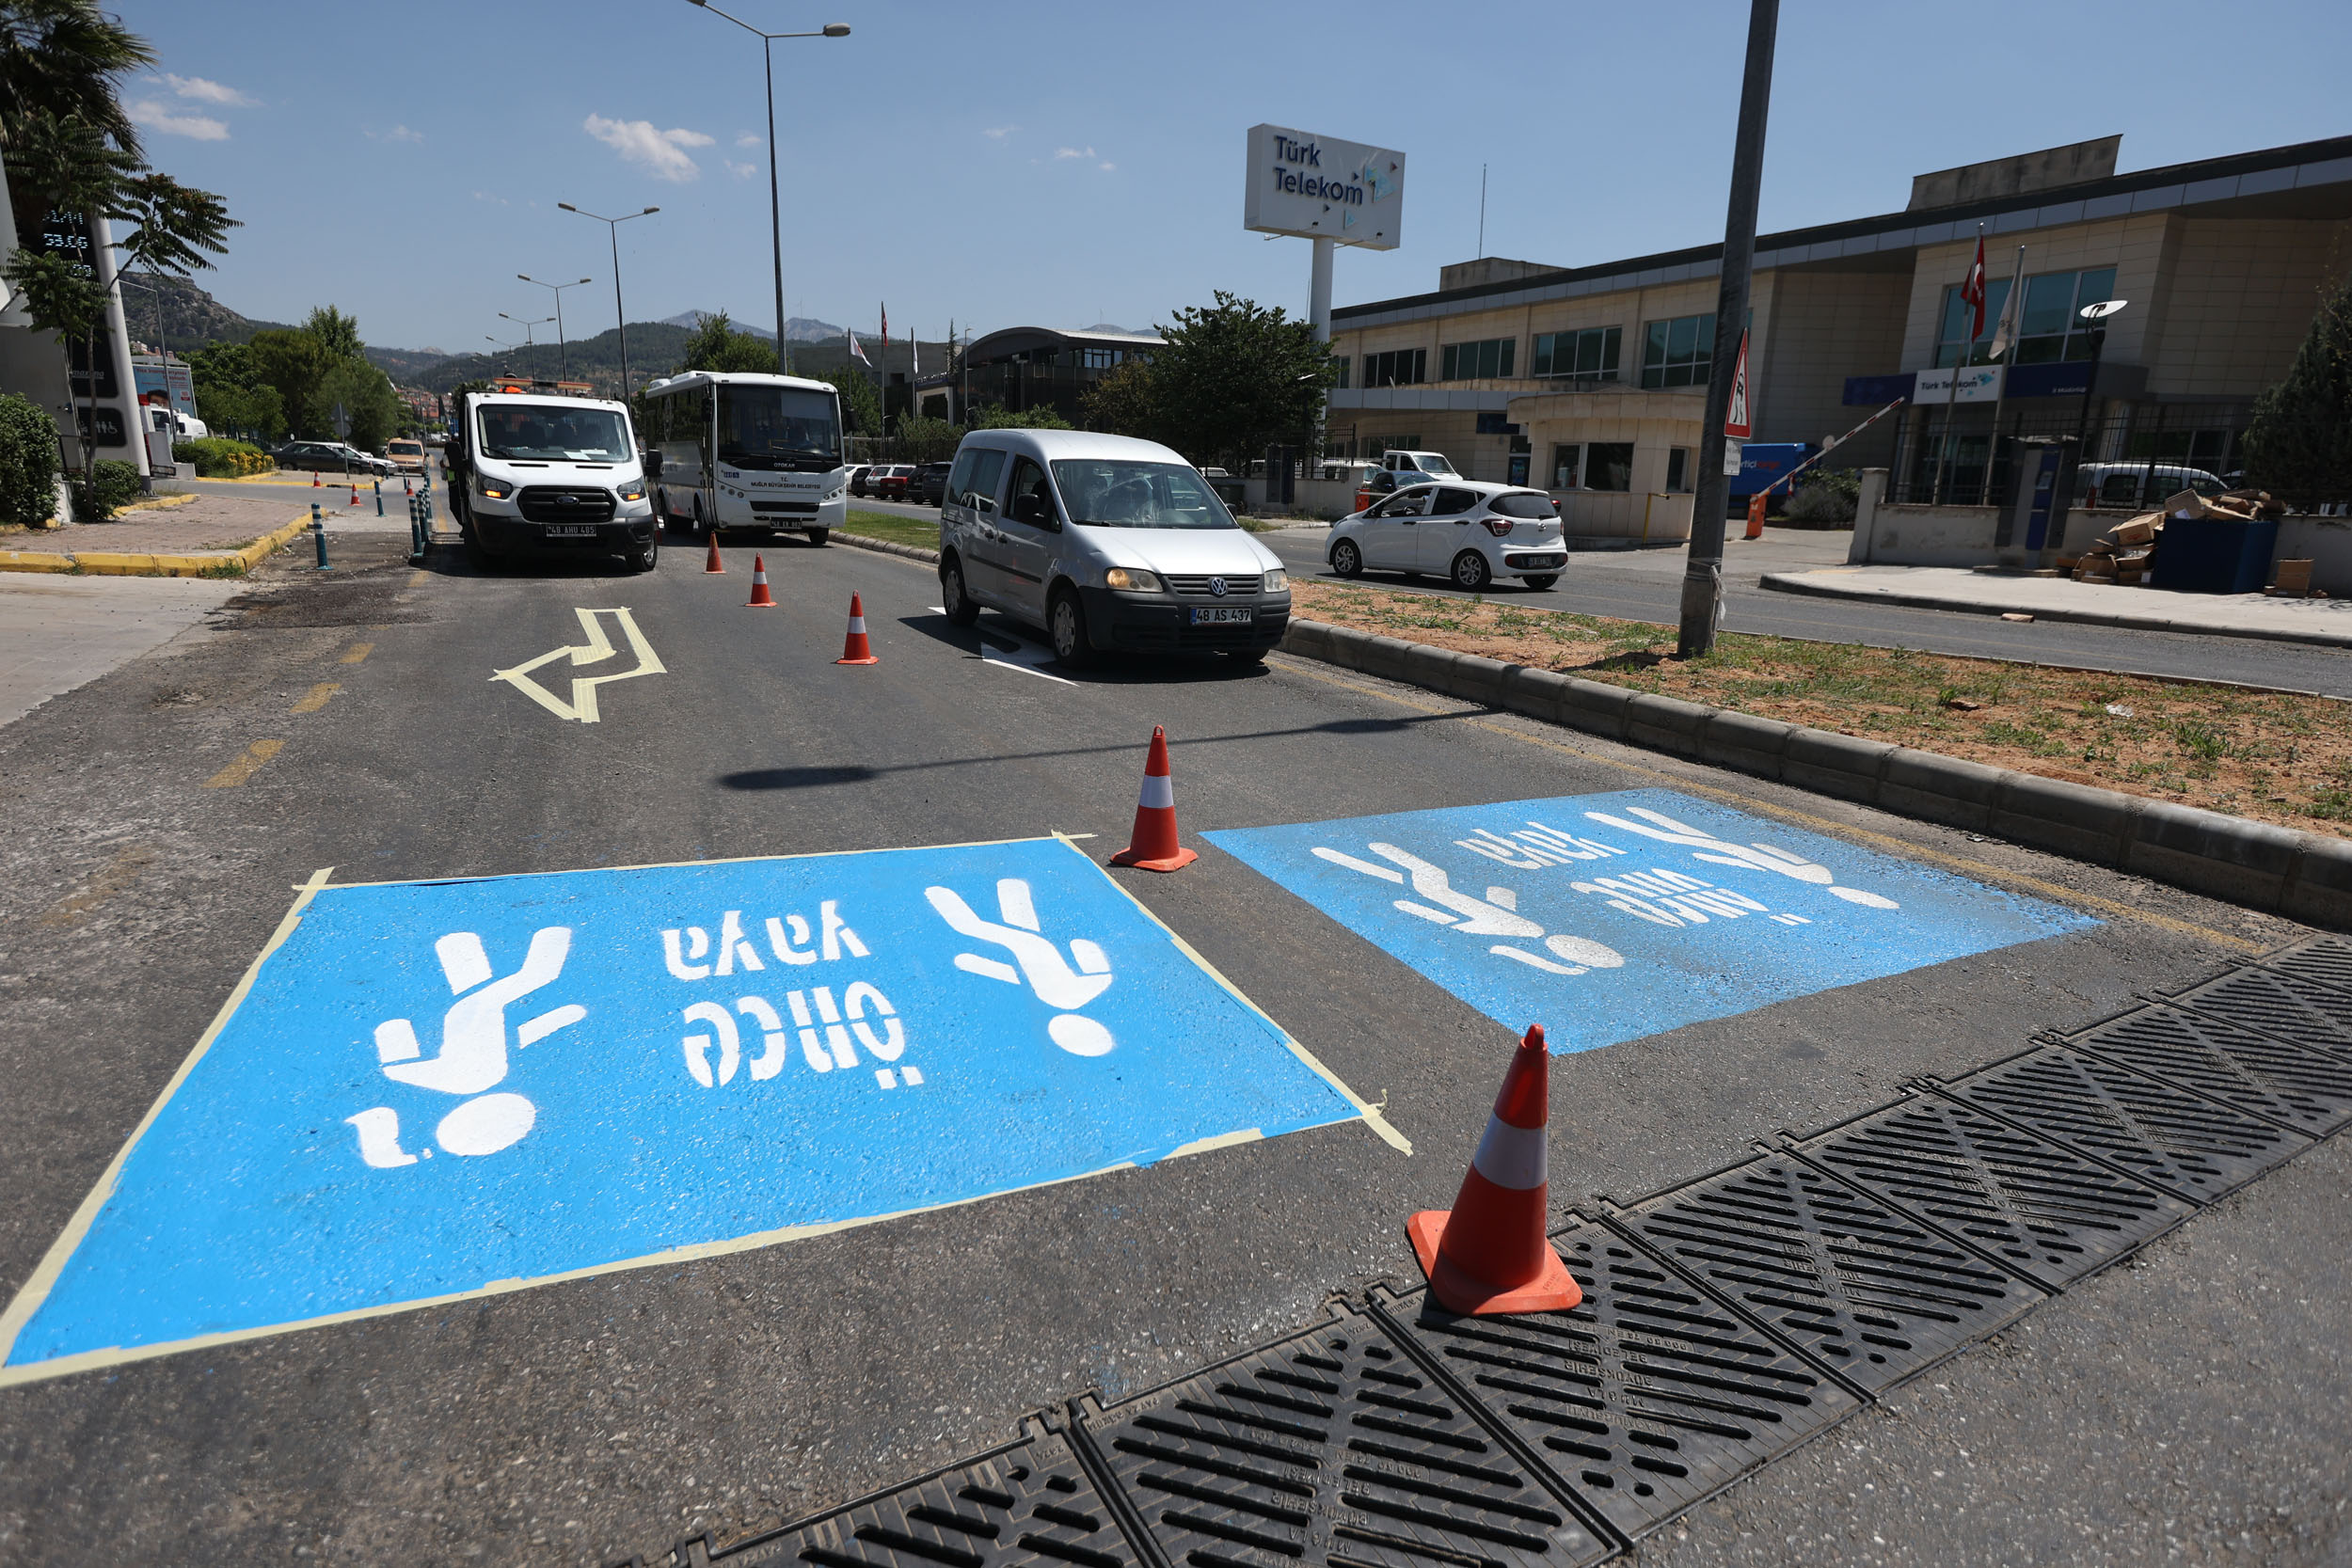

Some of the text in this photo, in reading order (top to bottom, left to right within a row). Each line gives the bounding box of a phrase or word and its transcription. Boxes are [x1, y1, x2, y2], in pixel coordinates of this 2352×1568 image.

[1275, 135, 1321, 166] Türk
[1274, 166, 1363, 205] Telekom
[1197, 610, 1250, 622] 48 AS 437
[661, 900, 871, 980] yaya
[682, 981, 925, 1088] önce
